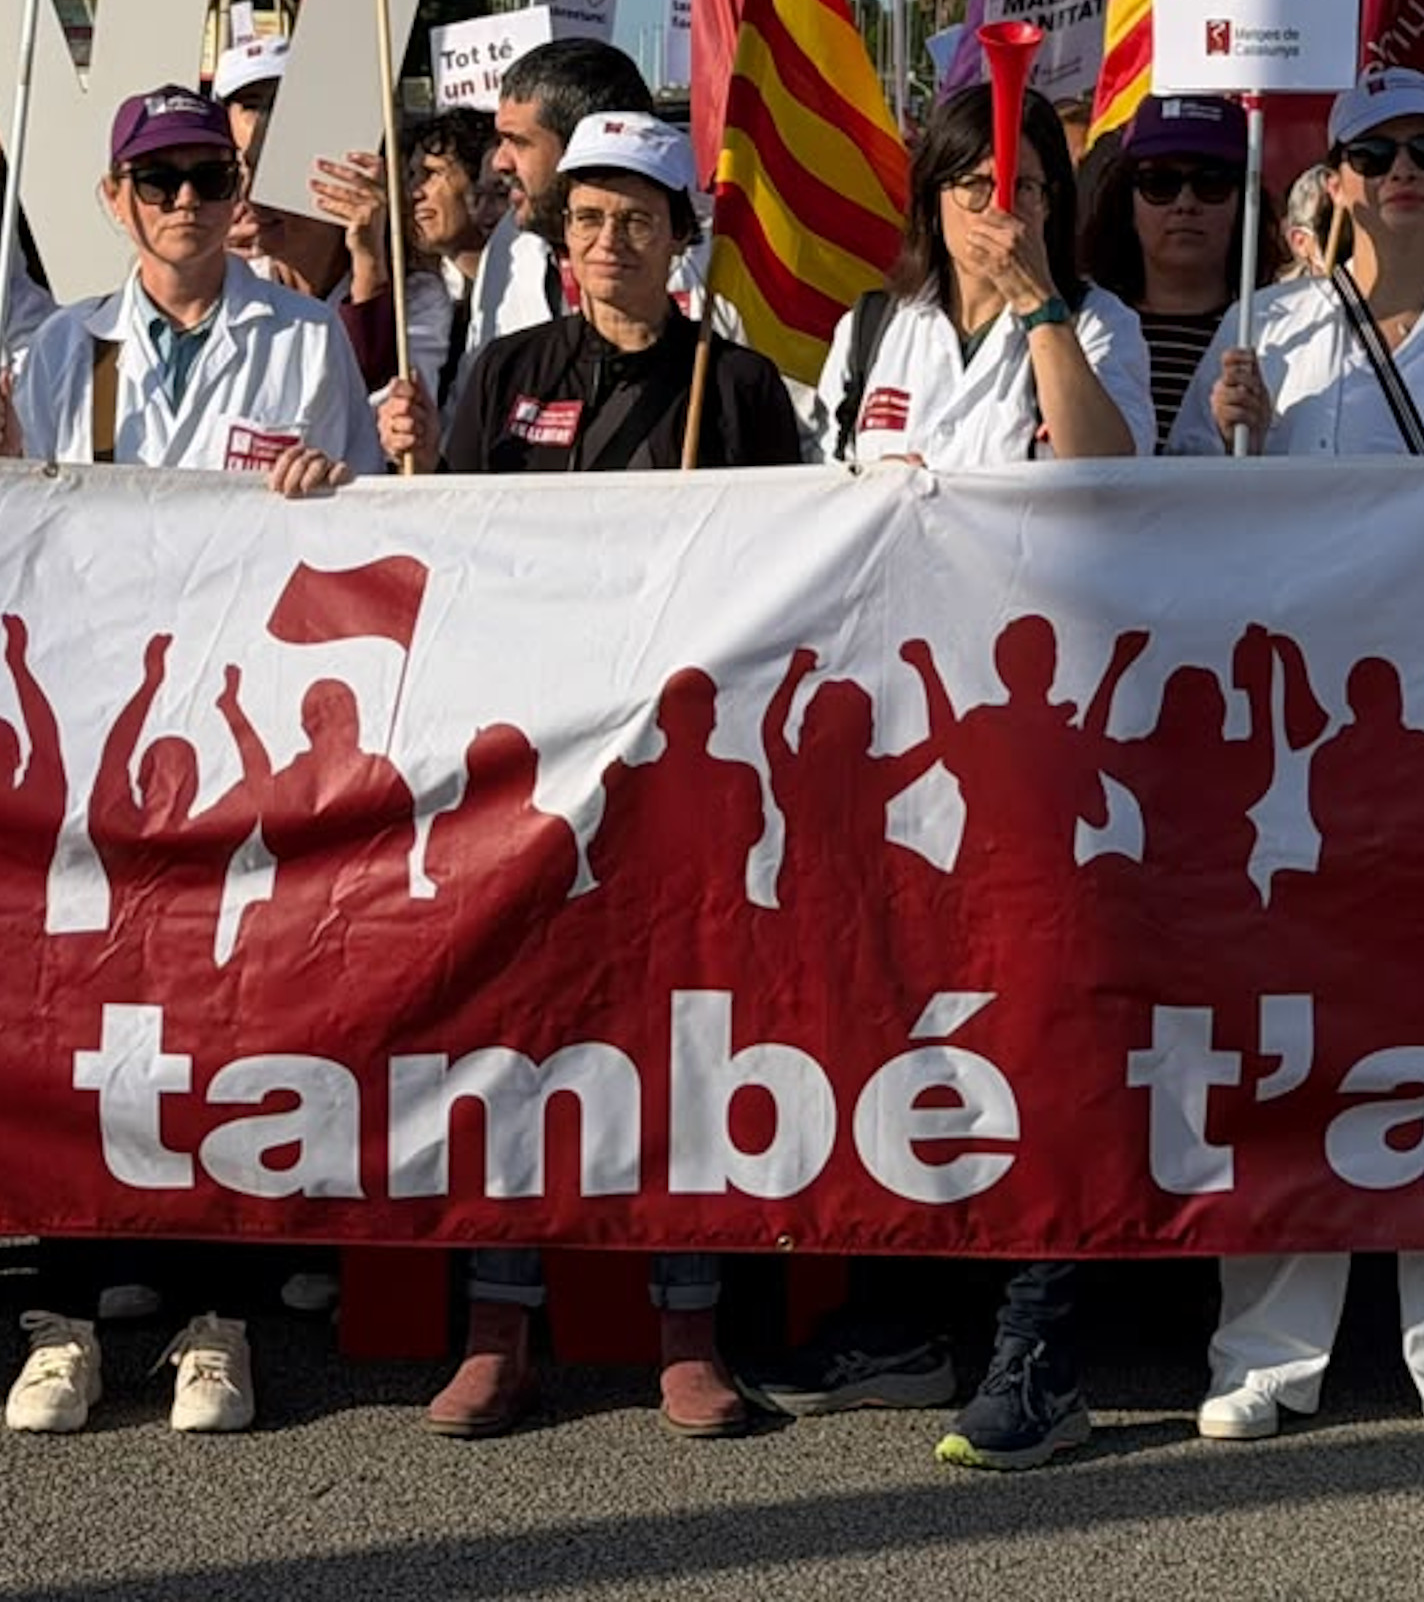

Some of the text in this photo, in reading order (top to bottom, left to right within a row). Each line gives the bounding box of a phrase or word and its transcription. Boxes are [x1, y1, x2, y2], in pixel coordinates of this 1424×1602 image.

[441, 38, 514, 70] Tot té
[443, 78, 475, 100] un
[72, 988, 1021, 1204] també
